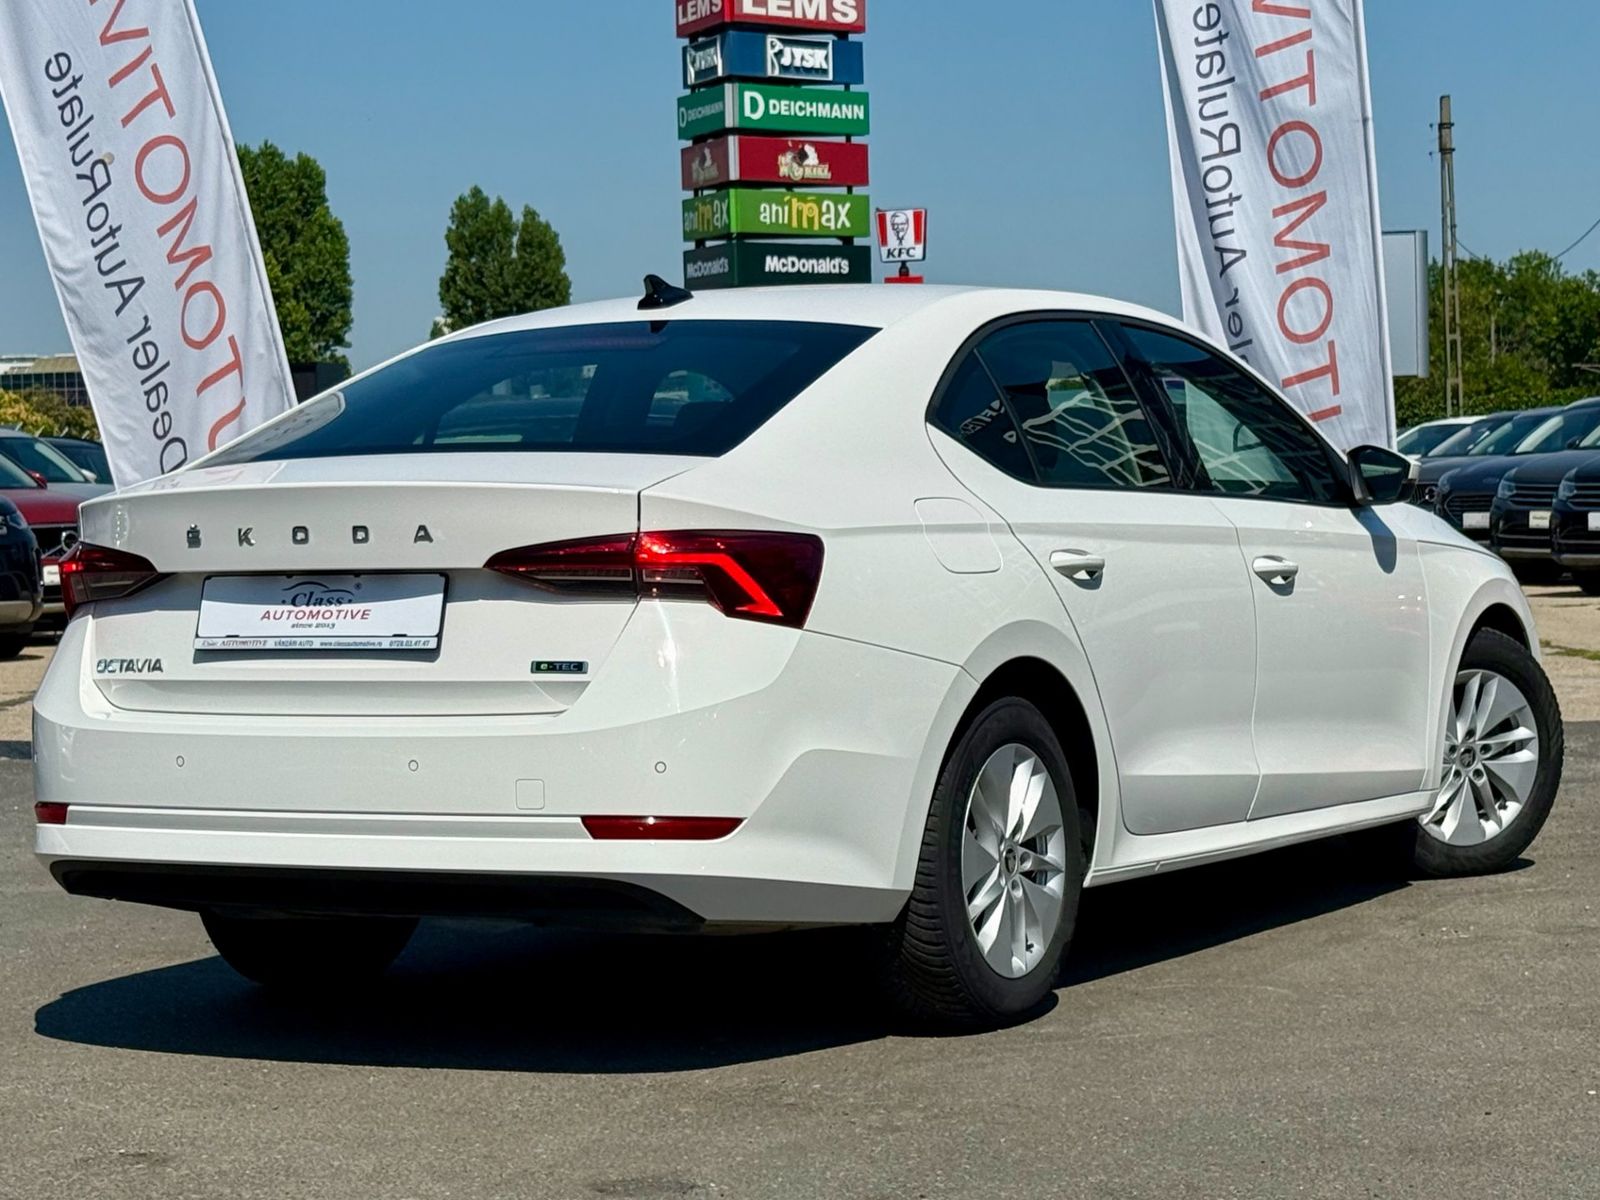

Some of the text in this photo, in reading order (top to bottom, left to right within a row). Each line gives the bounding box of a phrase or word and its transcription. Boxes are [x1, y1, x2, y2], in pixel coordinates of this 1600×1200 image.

[780, 46, 829, 69] JYSK
[769, 99, 865, 120] DEICHMANN
[760, 196, 851, 230] animax
[886, 246, 916, 259] KFC
[764, 255, 850, 274] McDonald's
[290, 591, 345, 607] Class
[260, 609, 371, 621] AUTOMOTIVE
[96, 658, 164, 674] OCTAVIA
